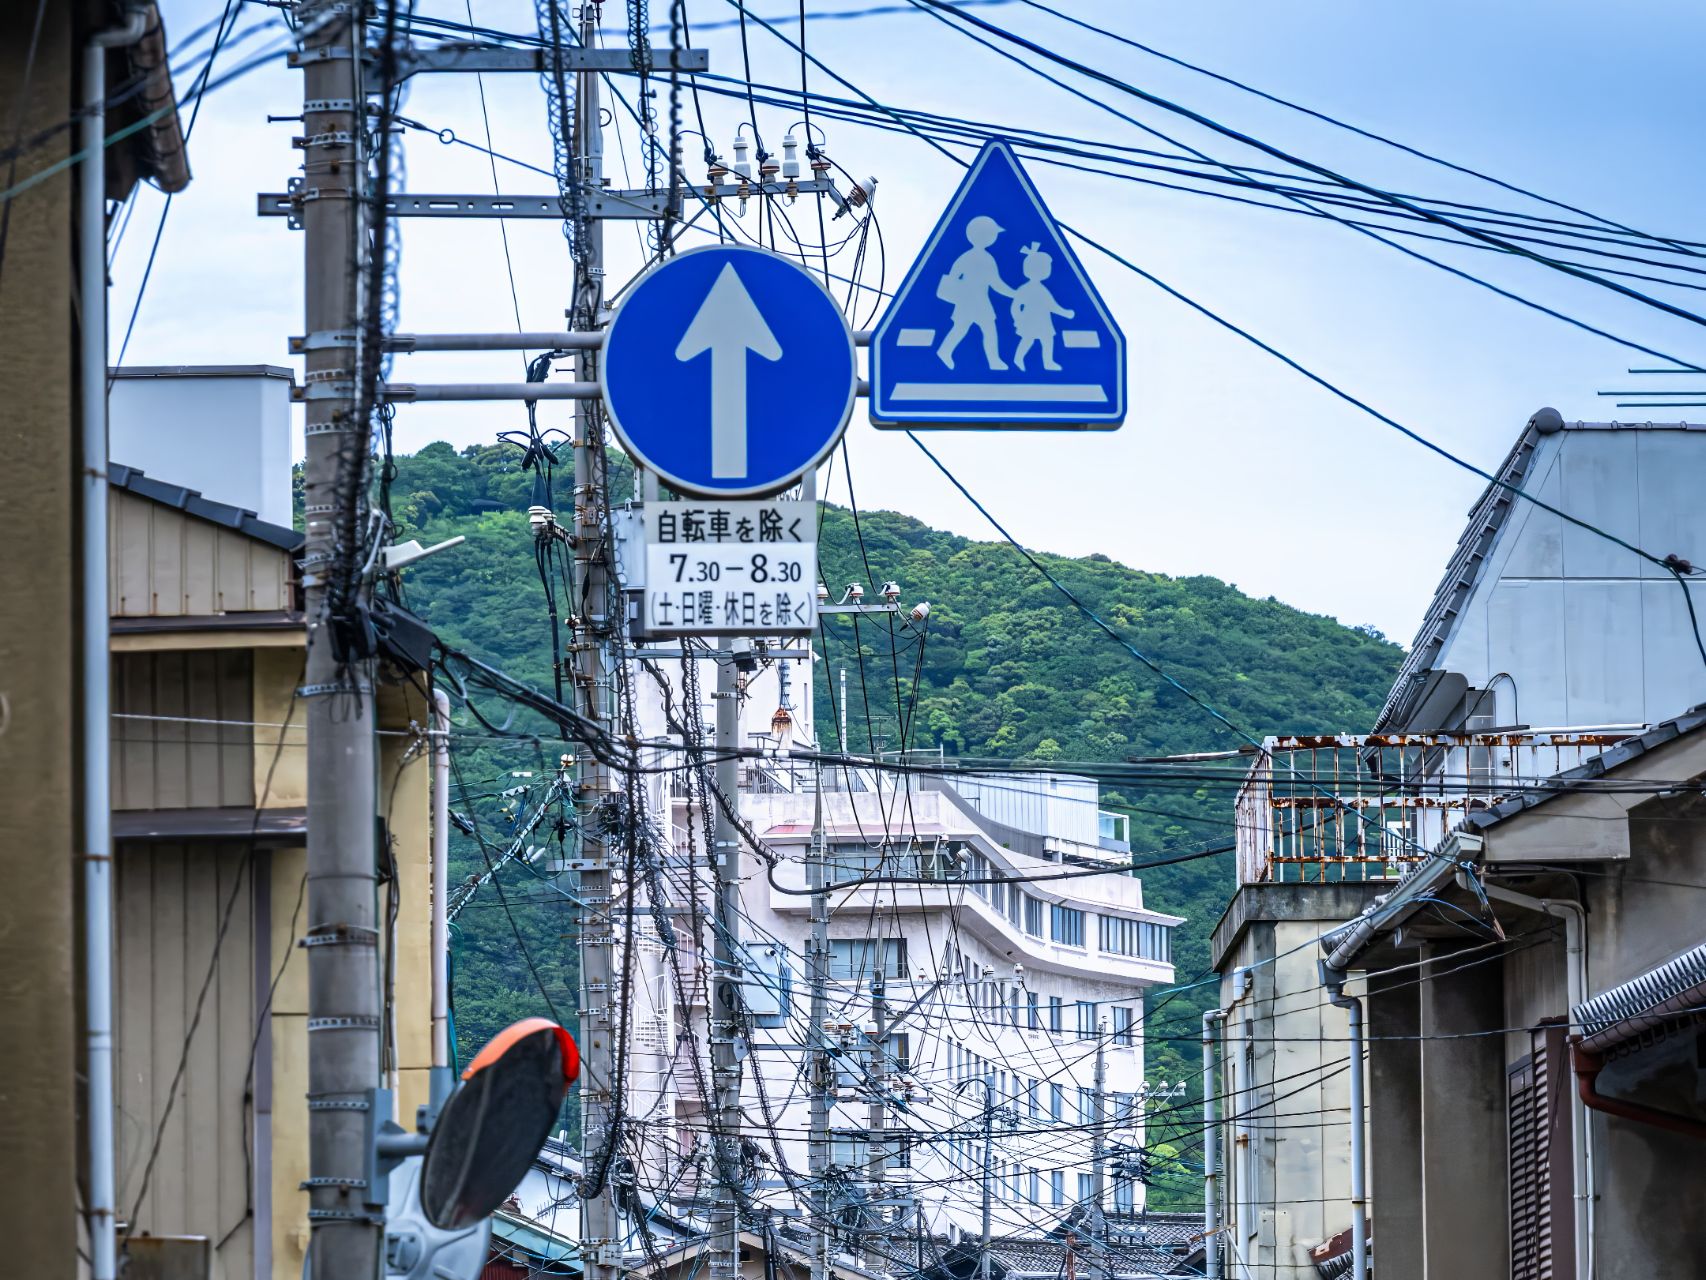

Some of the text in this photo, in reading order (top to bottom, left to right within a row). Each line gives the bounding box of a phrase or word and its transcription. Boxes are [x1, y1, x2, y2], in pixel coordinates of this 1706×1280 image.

[658, 508, 803, 543] 自転車を除く
